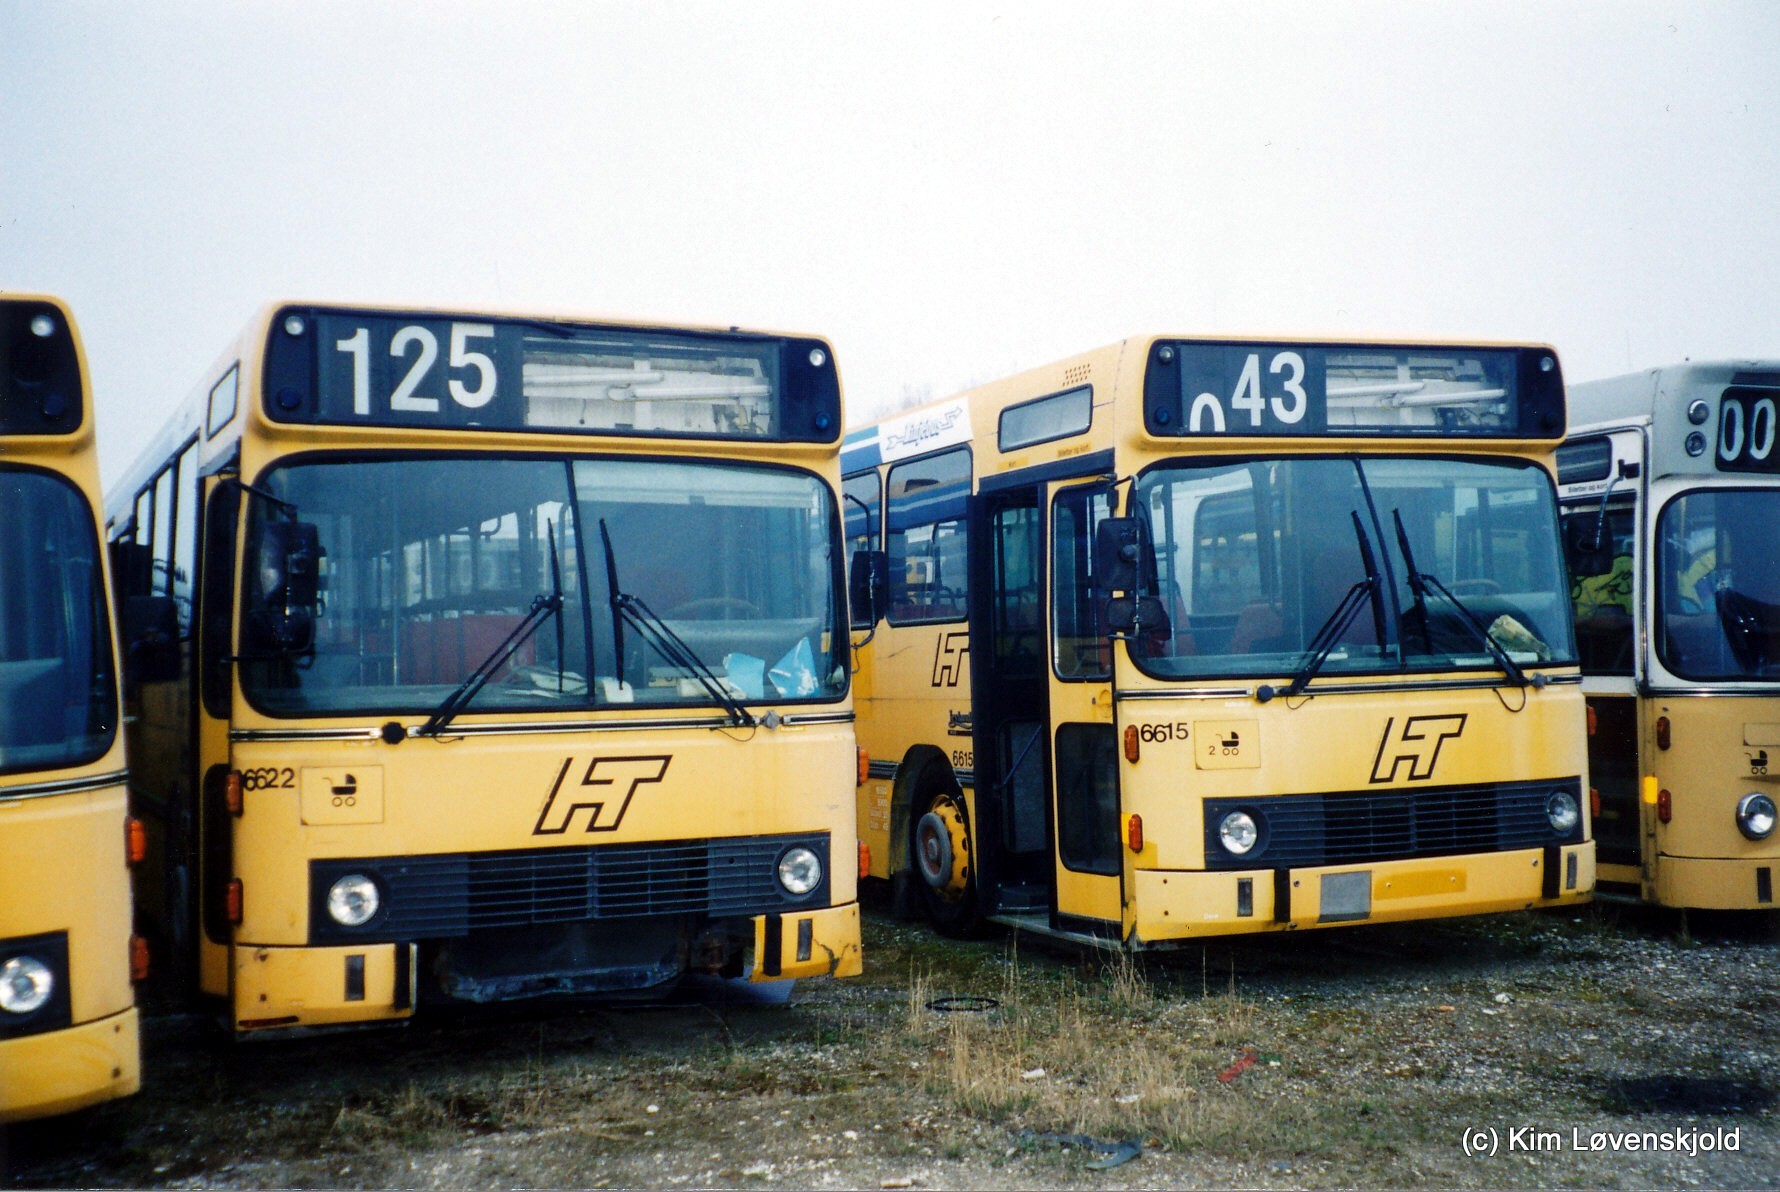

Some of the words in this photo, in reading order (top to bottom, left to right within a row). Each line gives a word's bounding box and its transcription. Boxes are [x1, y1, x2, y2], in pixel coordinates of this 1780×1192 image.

[336, 322, 497, 415] 125
[1140, 722, 1189, 743] 6615
[953, 750, 974, 767] 6615
[1208, 745, 1216, 756] 2
[1369, 713, 1468, 783] HT
[244, 766, 295, 792] 6622
[532, 755, 673, 835] HT
